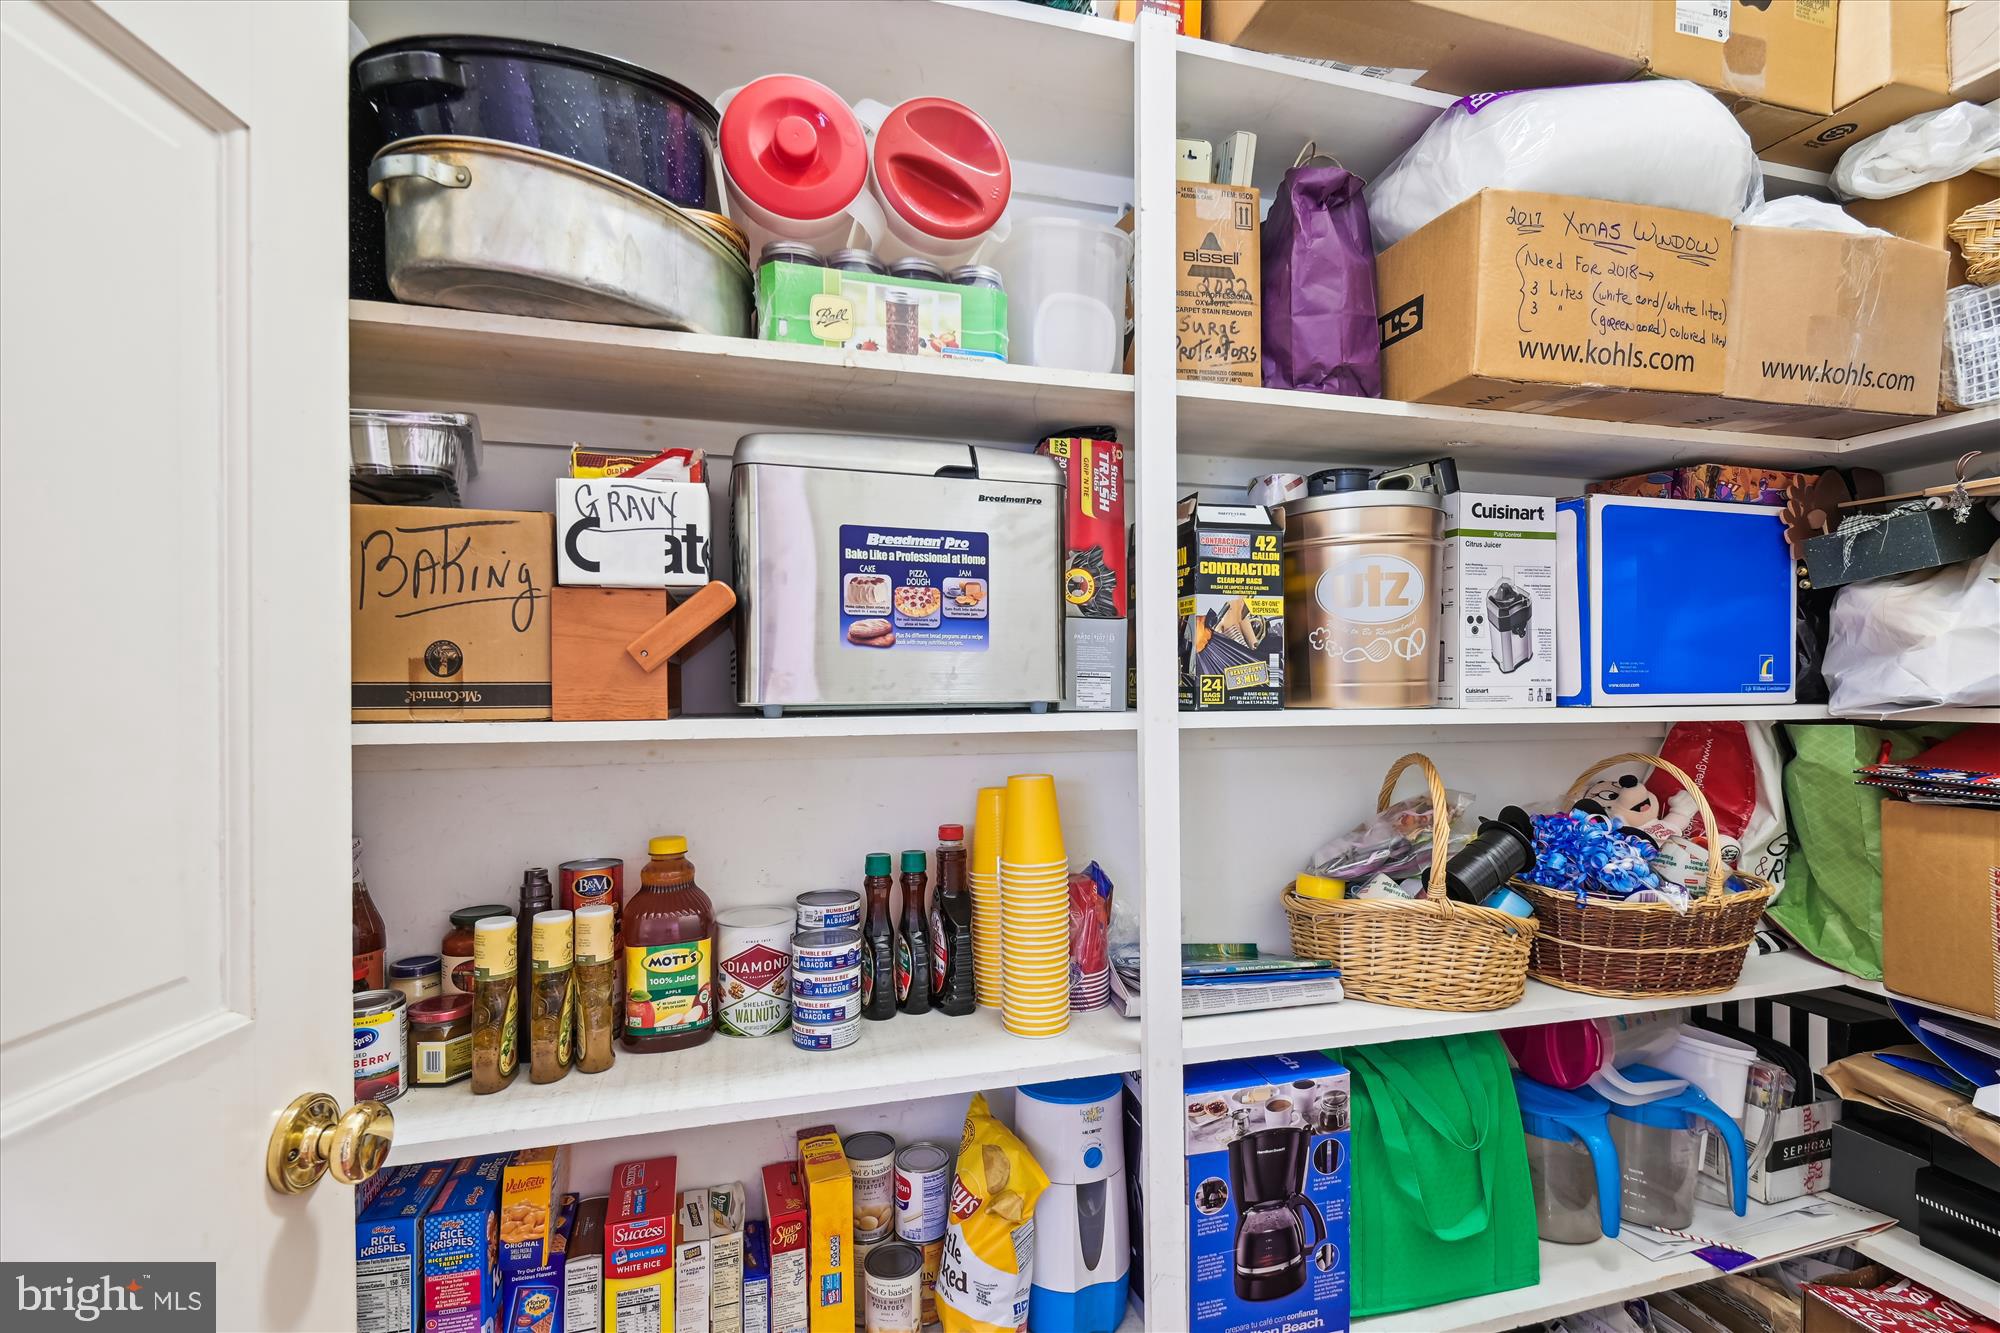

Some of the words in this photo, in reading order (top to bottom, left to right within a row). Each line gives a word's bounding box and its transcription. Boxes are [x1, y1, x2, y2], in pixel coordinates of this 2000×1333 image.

[1713, 8, 1728, 18] B95
[1717, 29, 1723, 37] S
[1505, 206, 1541, 225] 2017
[1524, 250, 1563, 270] Need
[1530, 281, 1539, 296] 3
[1202, 307, 1220, 315] STAIN
[1221, 309, 1253, 317] REMOVER
[1530, 301, 1539, 315] 3
[816, 307, 849, 327] Ball
[1519, 338, 1695, 372] www.kohls.com
[1761, 359, 1915, 392] www.kohls.com
[1059, 440, 1068, 455] 40
[606, 467, 620, 476] OLD
[1098, 452, 1110, 512] TRASH
[1110, 464, 1119, 501] Sturdy
[575, 484, 678, 535] GRAVY
[1471, 502, 1545, 521] Cuisinart
[866, 533, 942, 548] Breadman
[944, 537, 970, 550] Pro
[1255, 535, 1277, 551] 42
[1465, 540, 1483, 548] Citrus
[1483, 541, 1502, 549] Juicer
[845, 548, 868, 560] Bake
[869, 549, 887, 561] Like
[895, 550, 951, 564] Professional
[951, 554, 961, 564] at
[961, 554, 986, 565] Home
[1212, 546, 1238, 555] CHOICE
[1252, 552, 1280, 560] GALLON
[859, 564, 876, 573] CAKE
[909, 569, 928, 578] PIZZA
[958, 569, 972, 577] JAM
[1199, 561, 1280, 576] CONTRACTOR
[906, 577, 931, 586] DOUGH
[1202, 679, 1222, 691] 24
[407, 690, 482, 703] McCormick
[579, 877, 609, 892] B&M
[826, 906, 847, 914] BUMBLE
[826, 915, 855, 925] ALBACORE
[648, 952, 696, 967] MOTT'S
[728, 955, 789, 973] DIAMOND
[650, 977, 673, 985] 100%
[675, 974, 696, 983] Juice
[815, 984, 849, 995] ALBACORE
[743, 1000, 773, 1008] SHELLED
[735, 1005, 780, 1024] WALNUTS
[799, 1012, 831, 1020] ALBACORE
[354, 1033, 373, 1048] Spray
[1783, 1138, 1832, 1158] SEPHORA
[871, 1163, 893, 1176] basket
[505, 1176, 545, 1193] Velveeta
[855, 1182, 885, 1190] POTATOES
[371, 1234, 396, 1247] RICE
[440, 1228, 464, 1240] RICE
[615, 1225, 663, 1243] Success
[773, 1222, 802, 1246] Stove
[784, 1232, 799, 1248] Top
[360, 1243, 406, 1258] KRISPIES
[430, 1237, 474, 1252] KRISPIES
[504, 1241, 540, 1249] ORIGINAL
[651, 1247, 664, 1255] BAG
[444, 1253, 474, 1262] KRISPIES
[517, 1268, 525, 1276] Try
[616, 1262, 643, 1274] WHITE
[643, 1259, 661, 1269] RICE
[511, 1273, 536, 1282] Delicious
[888, 1285, 913, 1296] basket
[526, 1298, 548, 1308] Honey
[528, 1303, 545, 1312] Maid
[872, 1303, 904, 1311] POTATOES
[1259, 1318, 1273, 1327] café
[1273, 1316, 1287, 1324] con
[1286, 1308, 1318, 1321] confianza
[1282, 1317, 1323, 1333] Beach
